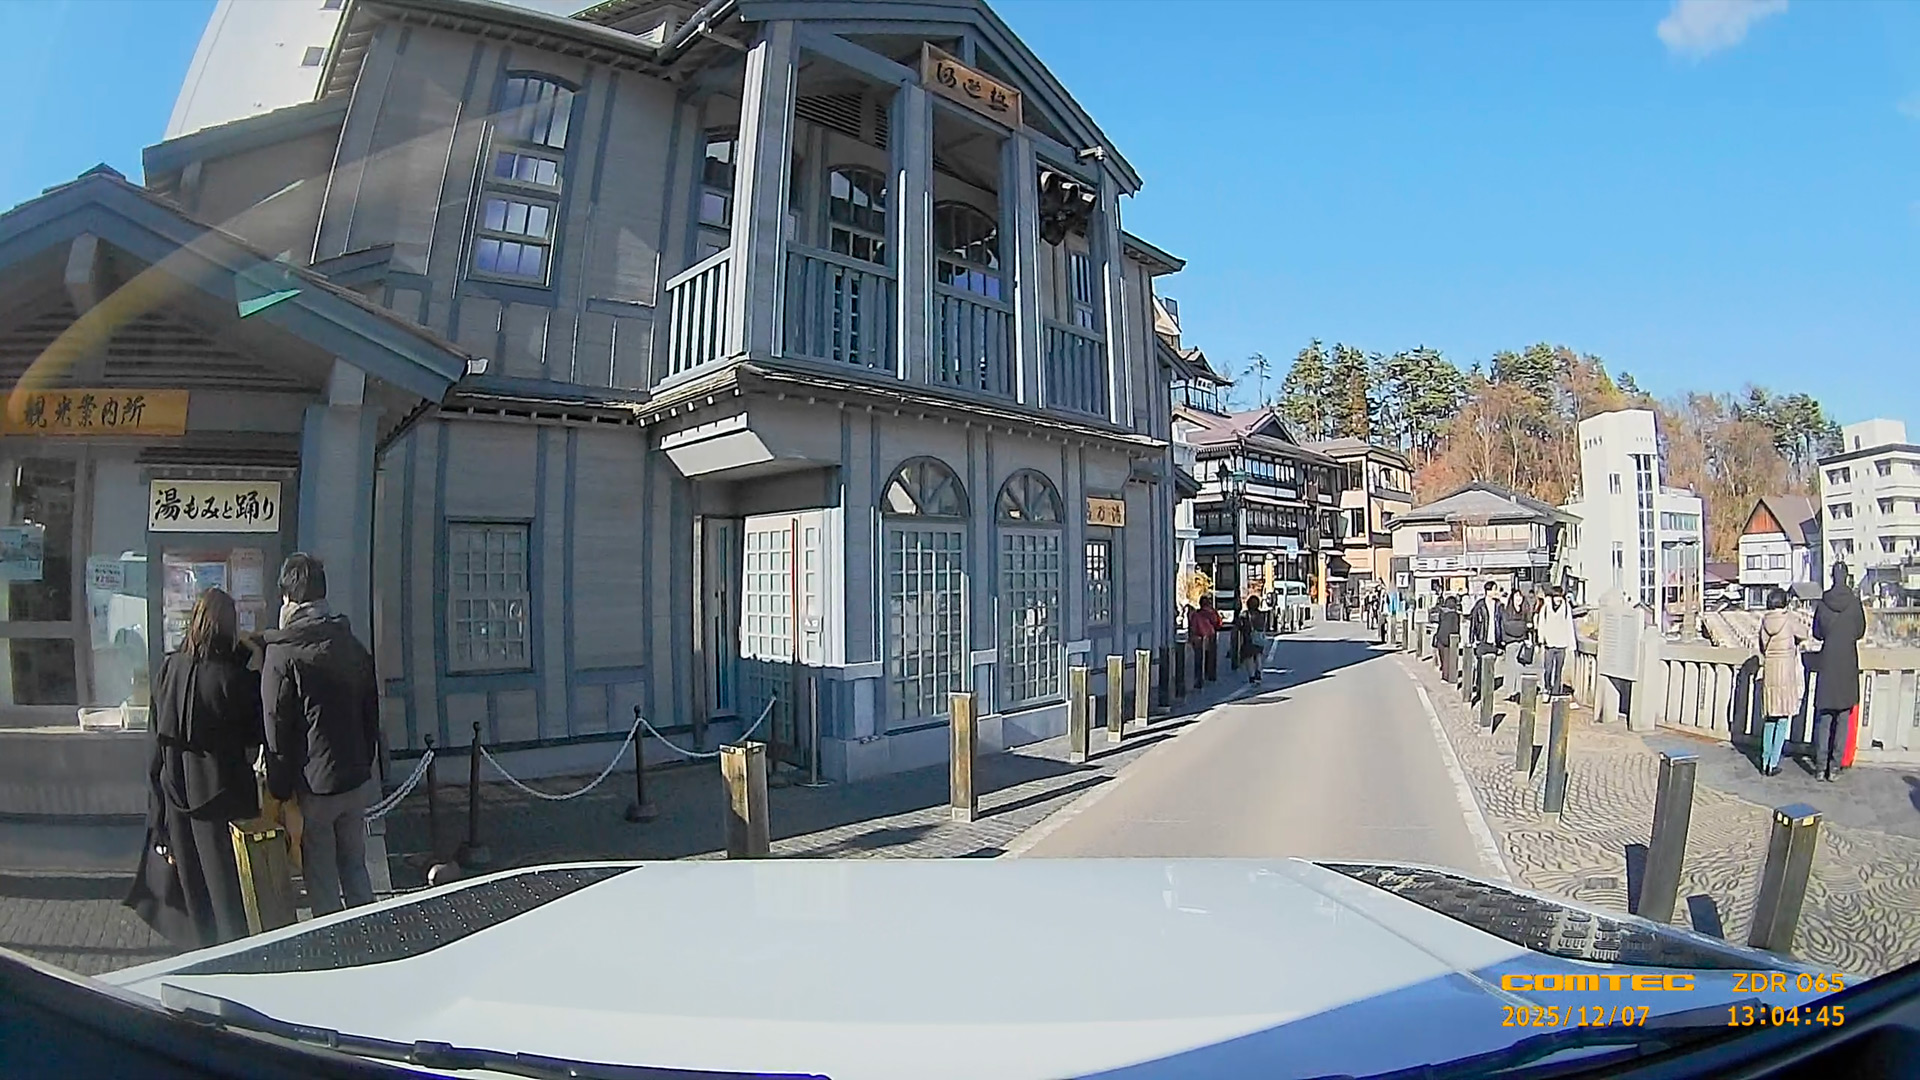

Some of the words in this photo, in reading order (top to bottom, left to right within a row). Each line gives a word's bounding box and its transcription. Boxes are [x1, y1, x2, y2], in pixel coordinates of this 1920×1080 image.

[24, 393, 147, 428] 観光案内所
[154, 487, 275, 525] 湯もみと踊り
[1399, 575, 1406, 586] 7
